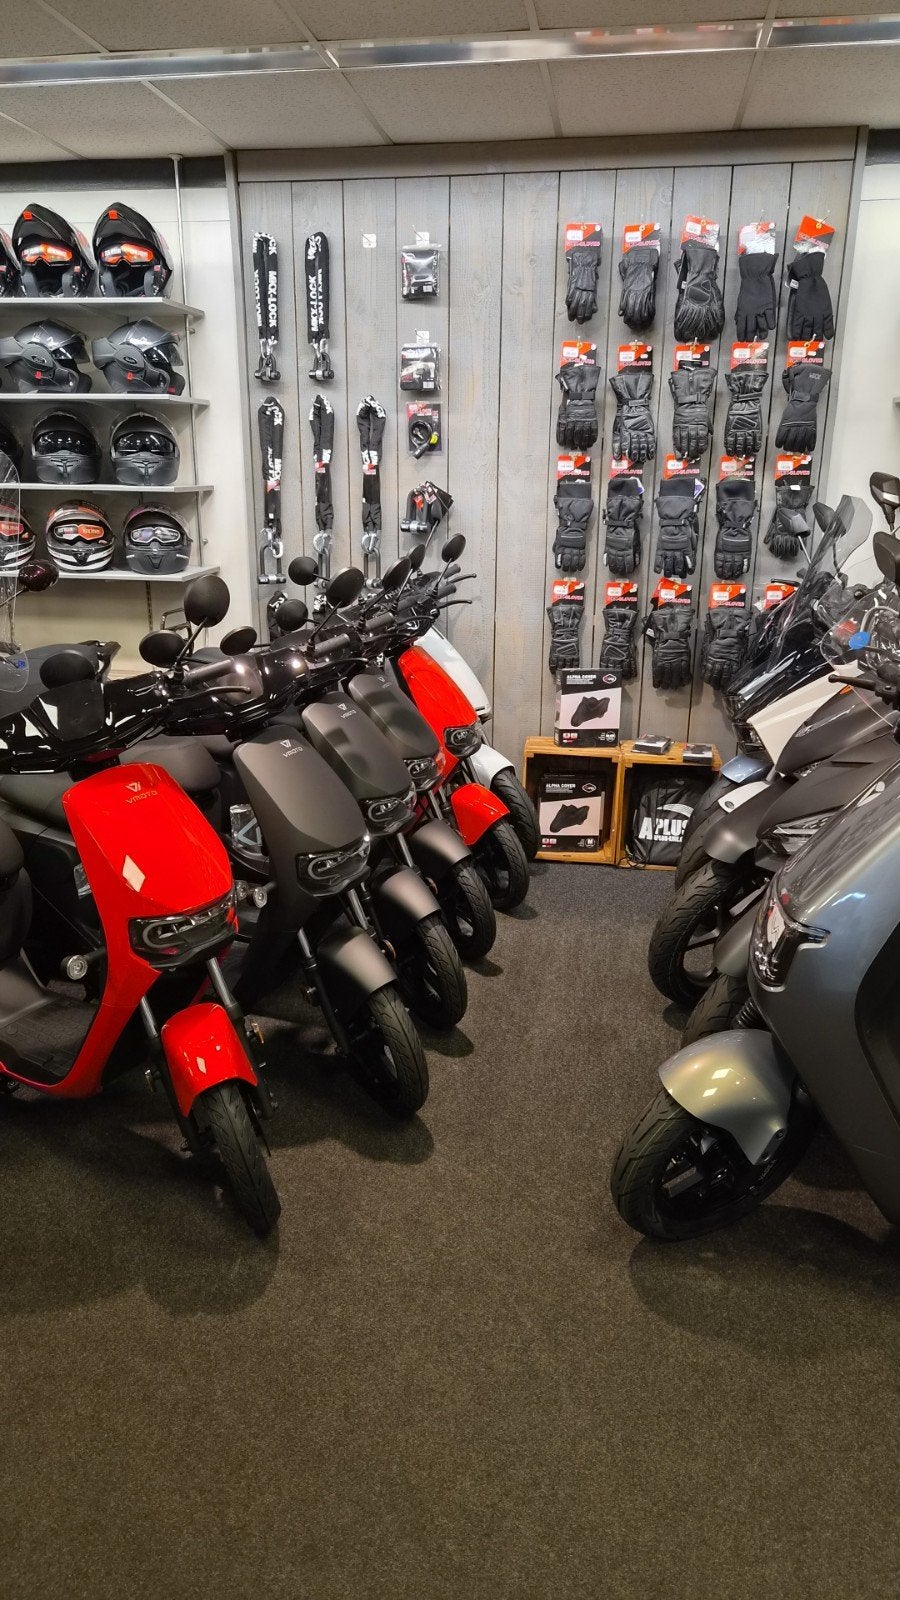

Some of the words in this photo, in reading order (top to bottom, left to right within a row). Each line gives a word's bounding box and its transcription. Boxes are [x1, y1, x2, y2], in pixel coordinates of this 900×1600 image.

[268, 271, 278, 328] MKX-LOCK
[308, 275, 319, 332] MKX-LOCK
[282, 746, 304, 758] VMOTO
[125, 790, 158, 804] VMOTO
